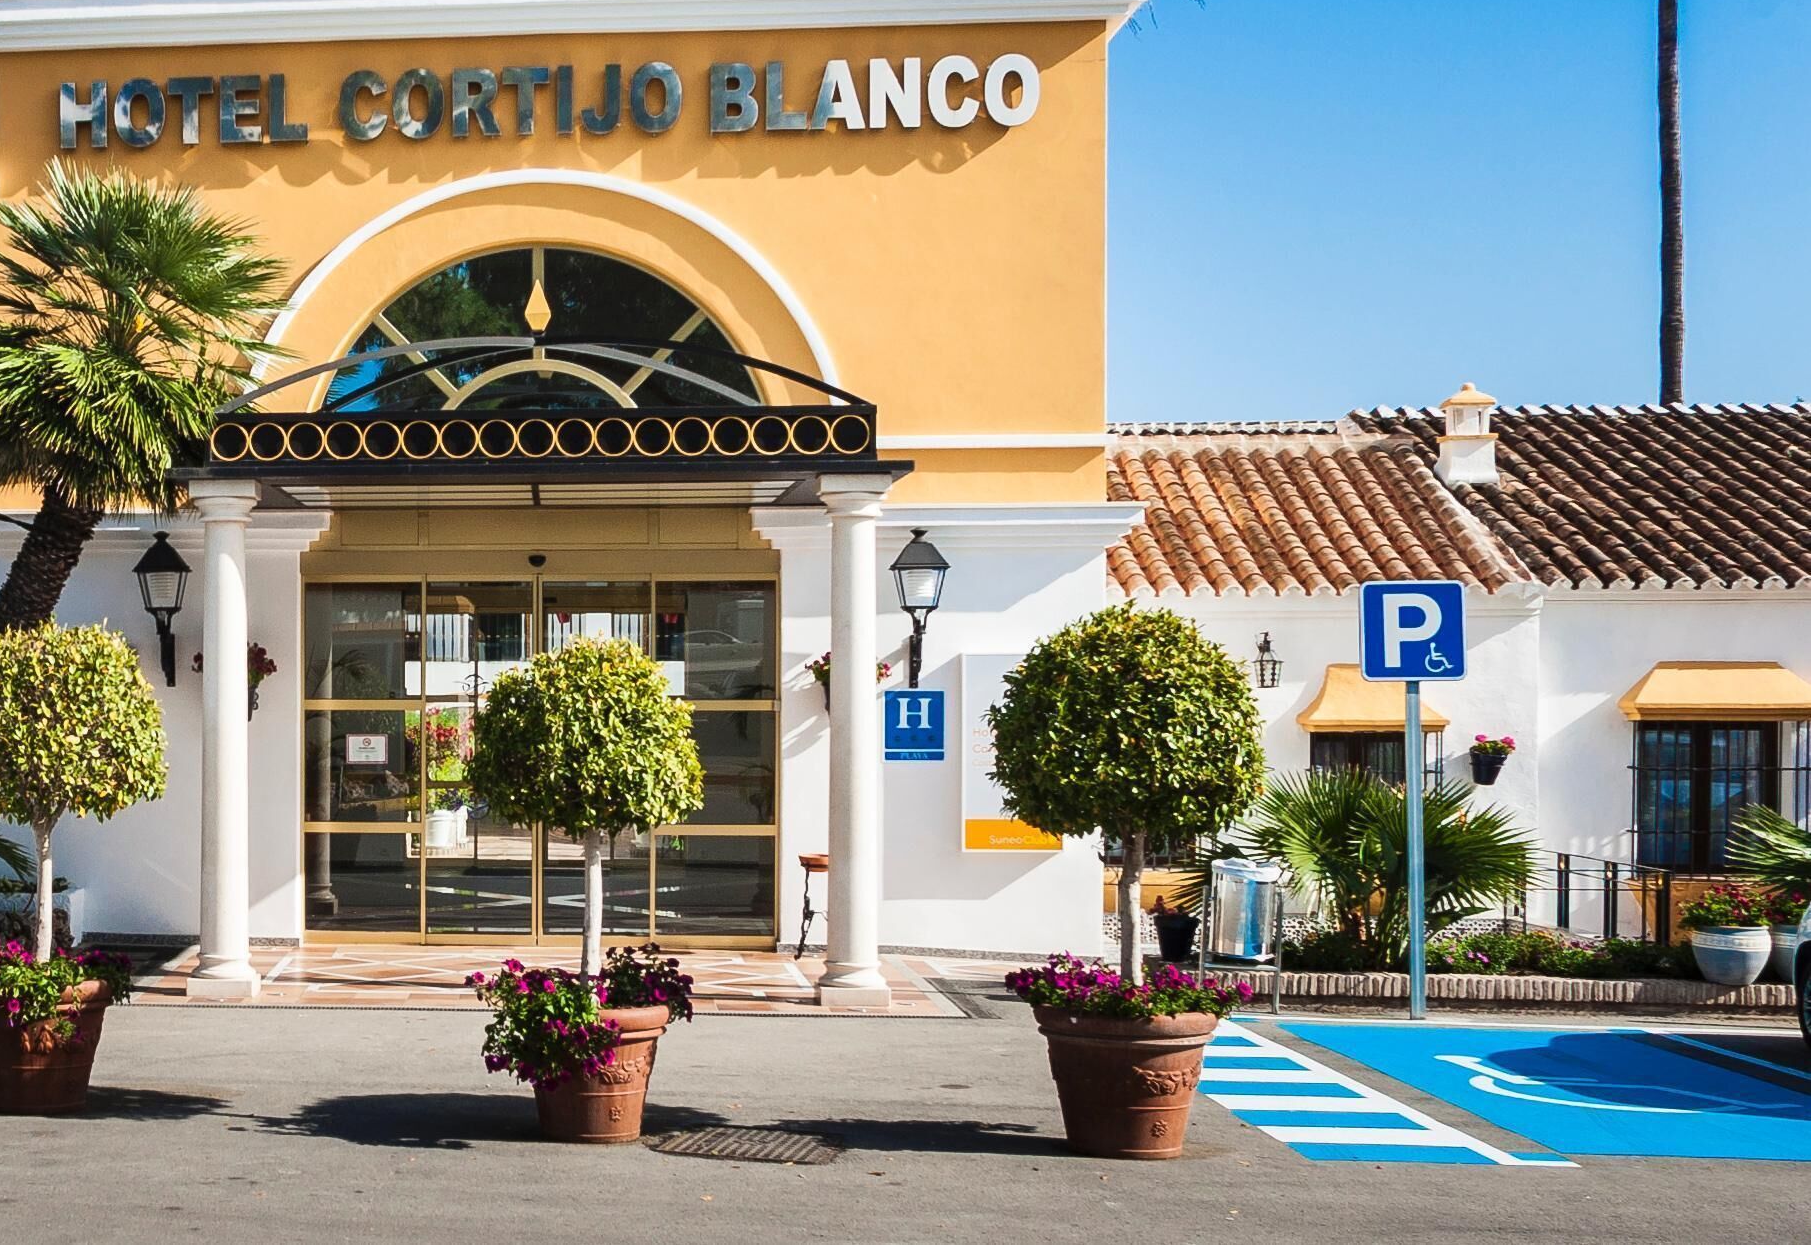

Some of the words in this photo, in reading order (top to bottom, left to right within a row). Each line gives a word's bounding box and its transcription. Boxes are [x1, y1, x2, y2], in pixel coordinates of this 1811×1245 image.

[59, 73, 310, 149] HOTEL
[338, 61, 683, 142] CORTIJO
[709, 53, 1040, 135] BLANCO
[1382, 592, 1443, 668] P
[895, 697, 933, 729] H
